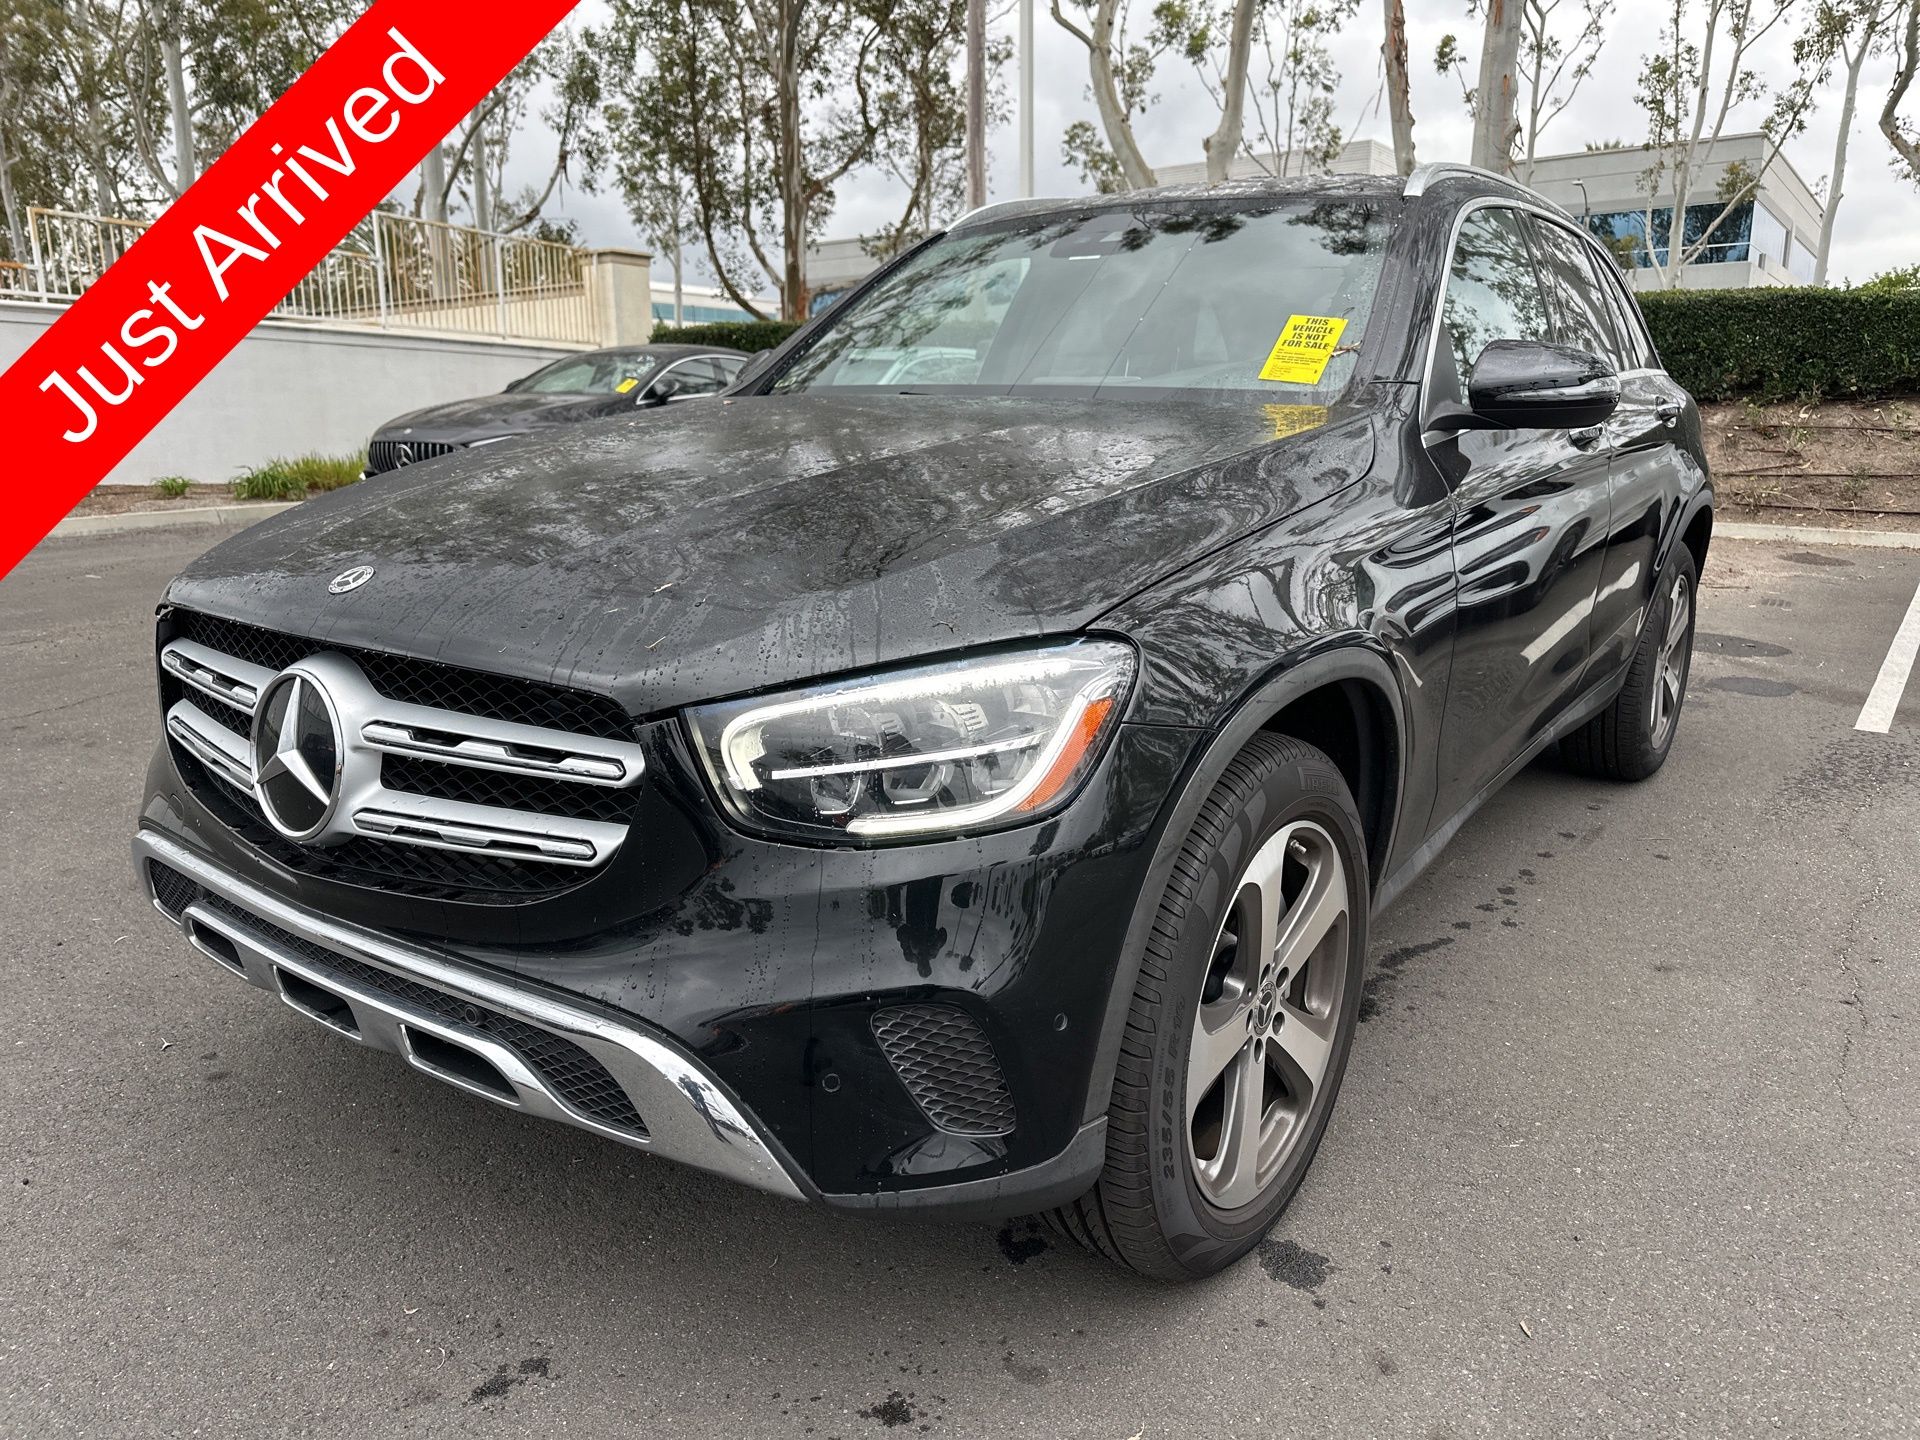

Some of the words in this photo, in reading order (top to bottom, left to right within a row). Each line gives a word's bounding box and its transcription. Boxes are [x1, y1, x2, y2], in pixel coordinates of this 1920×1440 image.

[1293, 324, 1335, 334] VEHICLE
[1305, 333, 1327, 341] NOT
[1281, 339, 1302, 347] FOR
[1303, 341, 1330, 350] SALE
